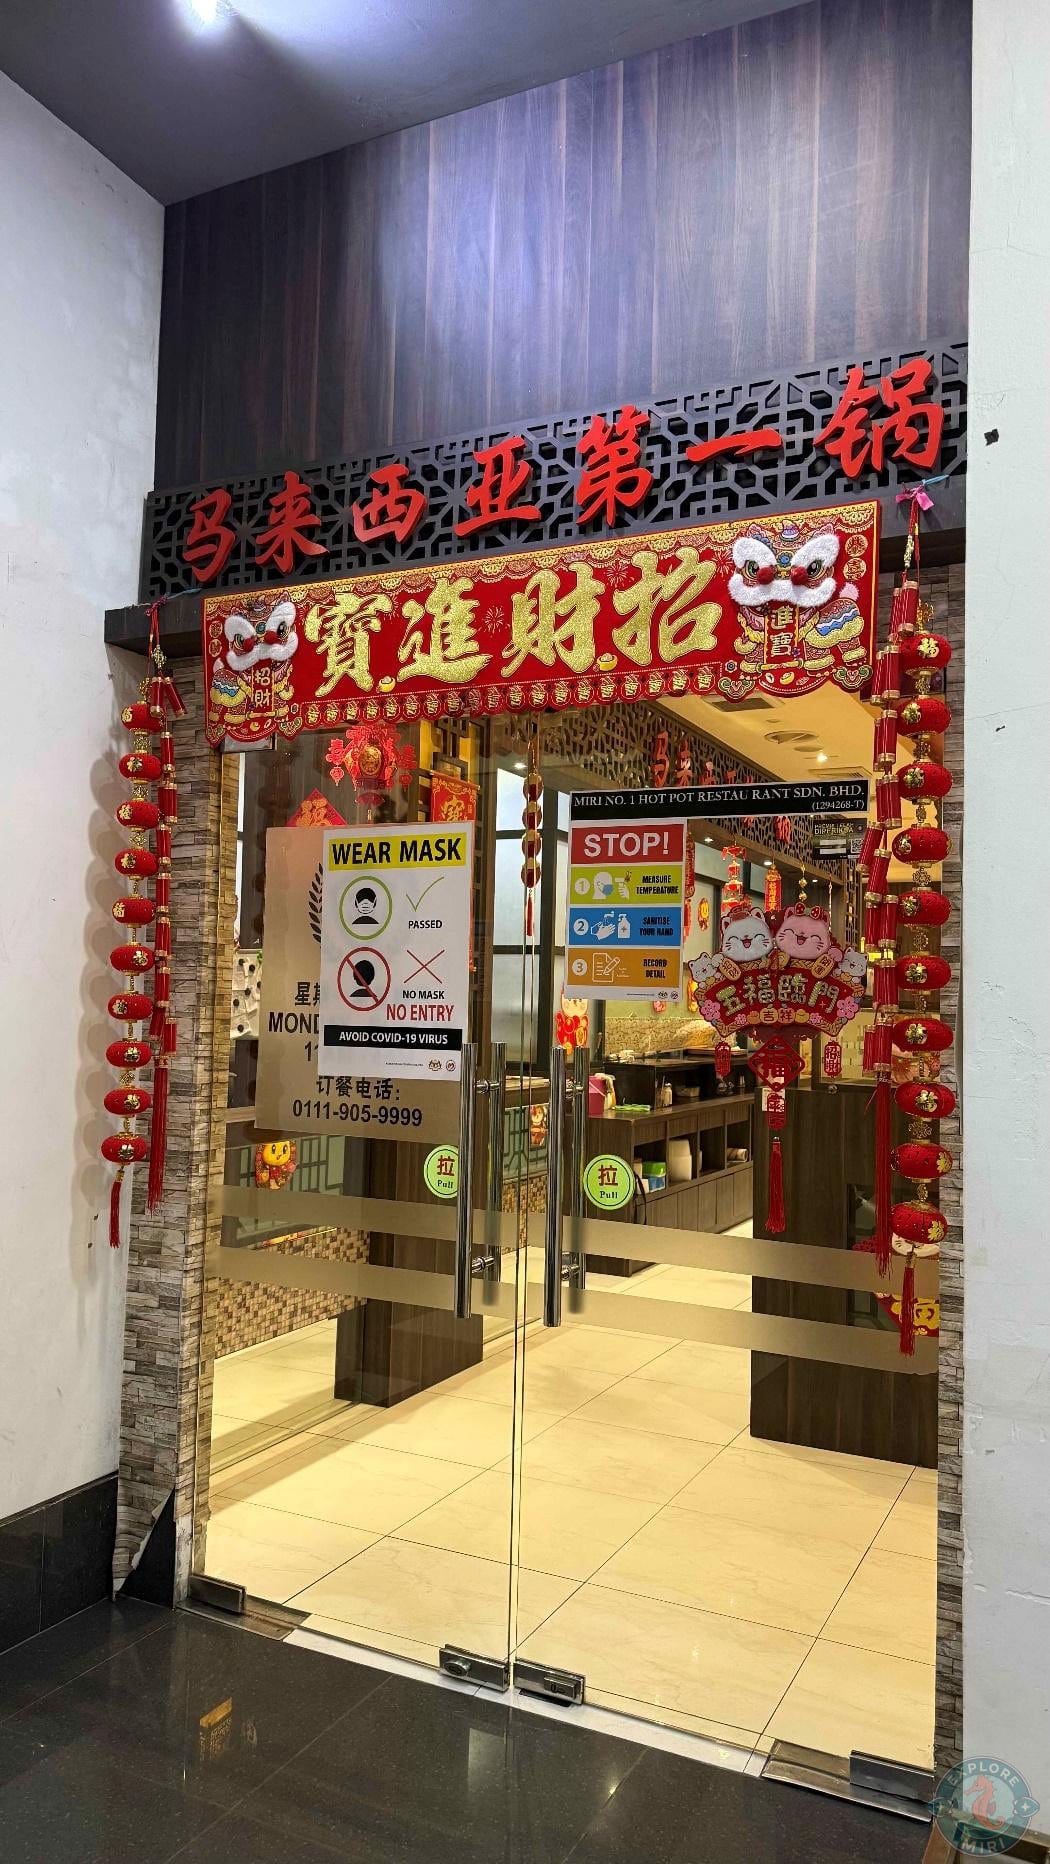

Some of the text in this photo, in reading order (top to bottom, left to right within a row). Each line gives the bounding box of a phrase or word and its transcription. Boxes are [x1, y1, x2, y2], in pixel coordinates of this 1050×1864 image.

[183, 357, 944, 581] 马来西亚第一锅
[574, 796, 602, 807] MIRI
[604, 795, 628, 806] NO.
[639, 793, 667, 804] HOT
[669, 792, 695, 803] POT
[698, 790, 748, 802] RESTAU
[752, 788, 792, 800] RANT
[794, 786, 826, 798] SDN.
[829, 784, 865, 797] BHD.
[812, 800, 865, 811] (1294268-T)
[584, 832, 669, 857] STOP!
[332, 838, 462, 865] WEAR MASK
[642, 874, 671, 883] MEASURE
[636, 886, 679, 895] TEMPERATURE
[408, 920, 443, 929] PASSED
[643, 916, 670, 926] SANITISE
[639, 927, 674, 936] YOUR HAND
[643, 959, 667, 967] RECORD
[645, 969, 666, 979] DETAIL
[402, 990, 445, 1000] NO MASK
[387, 1003, 454, 1021] NO ENTRY
[339, 1031, 448, 1044] AVOID COVID-19 VIRUS
[292, 1100, 423, 1127] 0111-905-9999
[436, 1155, 455, 1176] 拉
[598, 1164, 619, 1186] 拉
[437, 1180, 454, 1188] Pull
